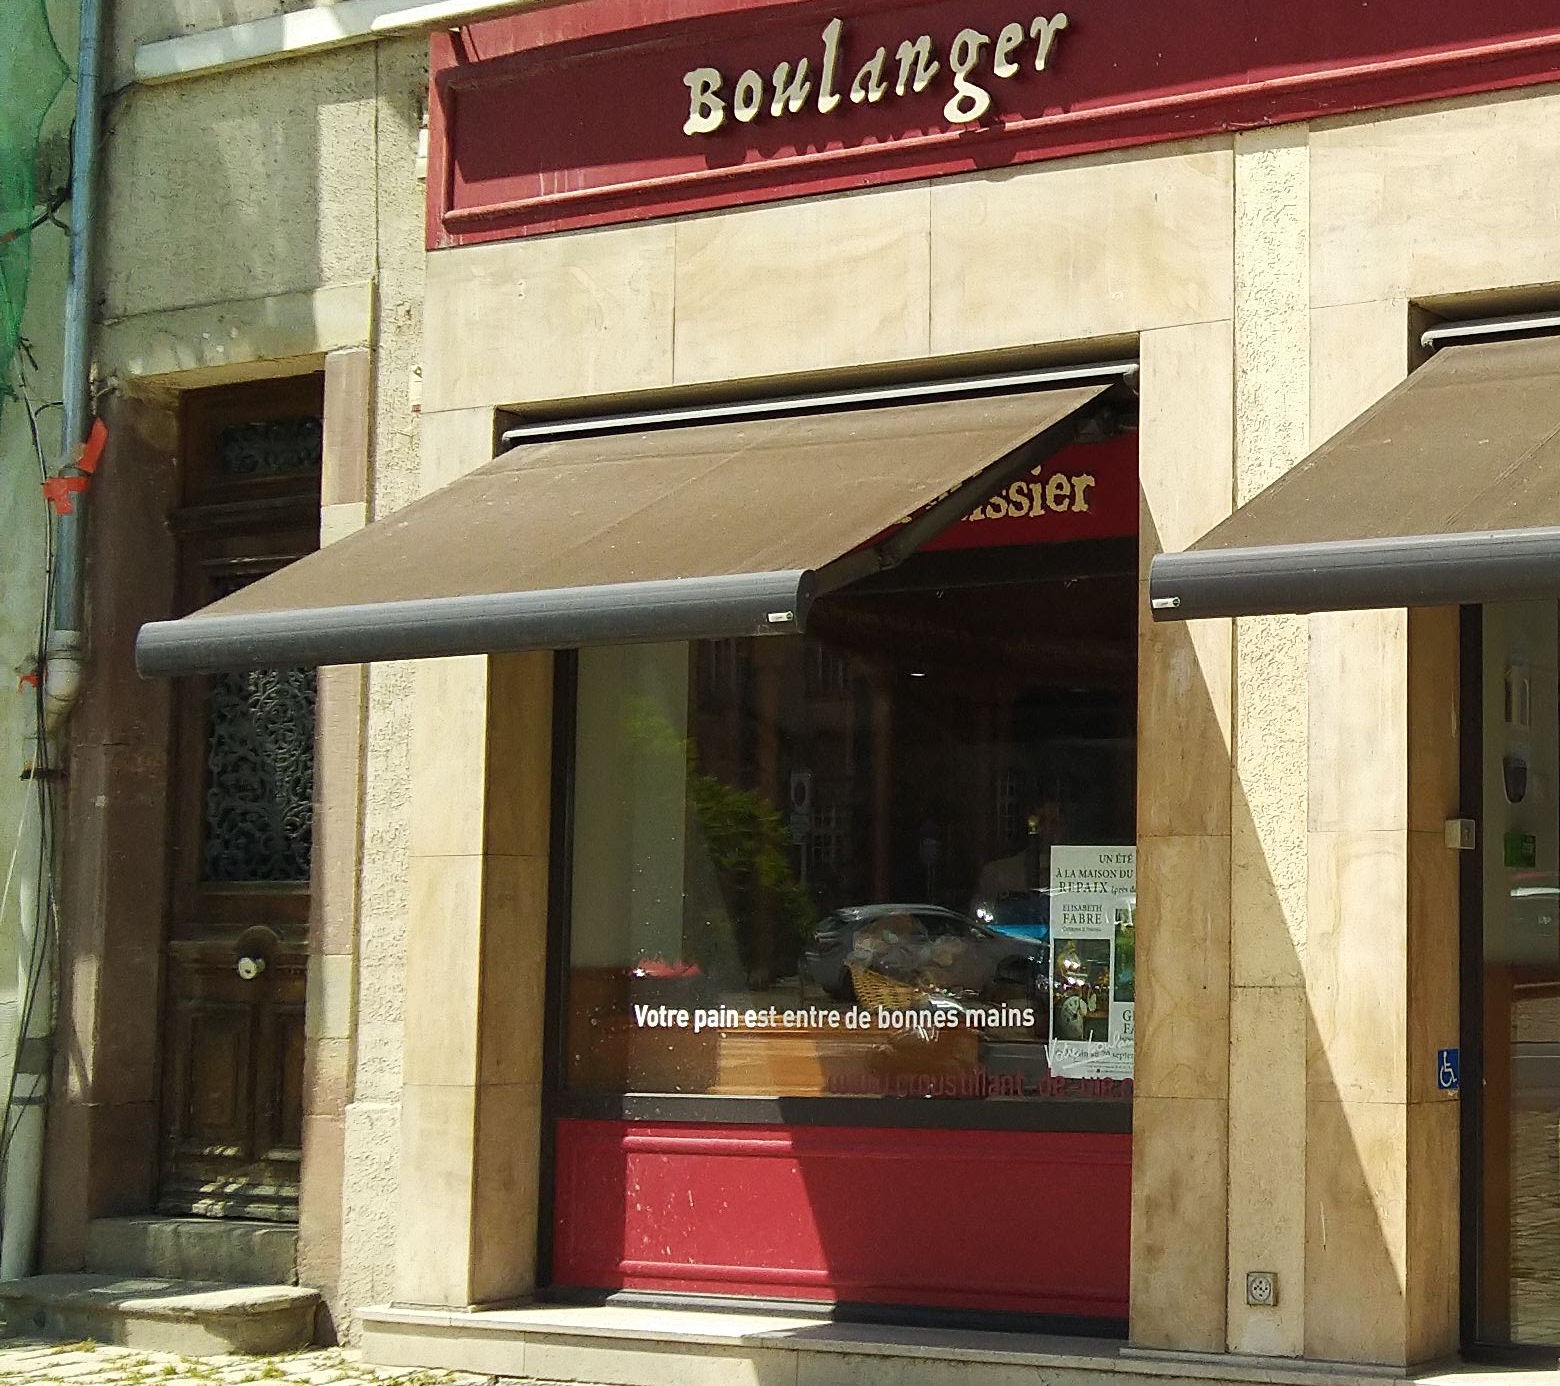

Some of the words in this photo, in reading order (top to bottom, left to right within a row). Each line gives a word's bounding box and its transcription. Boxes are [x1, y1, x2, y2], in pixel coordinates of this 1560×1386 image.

[682, 17, 1070, 137] Boulanger
[1079, 870, 1117, 878] MAISON
[1063, 913, 1102, 924] FABRE
[634, 1004, 690, 1028] Votre
[694, 1004, 739, 1033] pain
[744, 1005, 777, 1028] est
[782, 1005, 840, 1028] entre
[845, 1006, 871, 1029] de
[878, 1005, 959, 1029] bonnes
[965, 1002, 1035, 1027] mains
